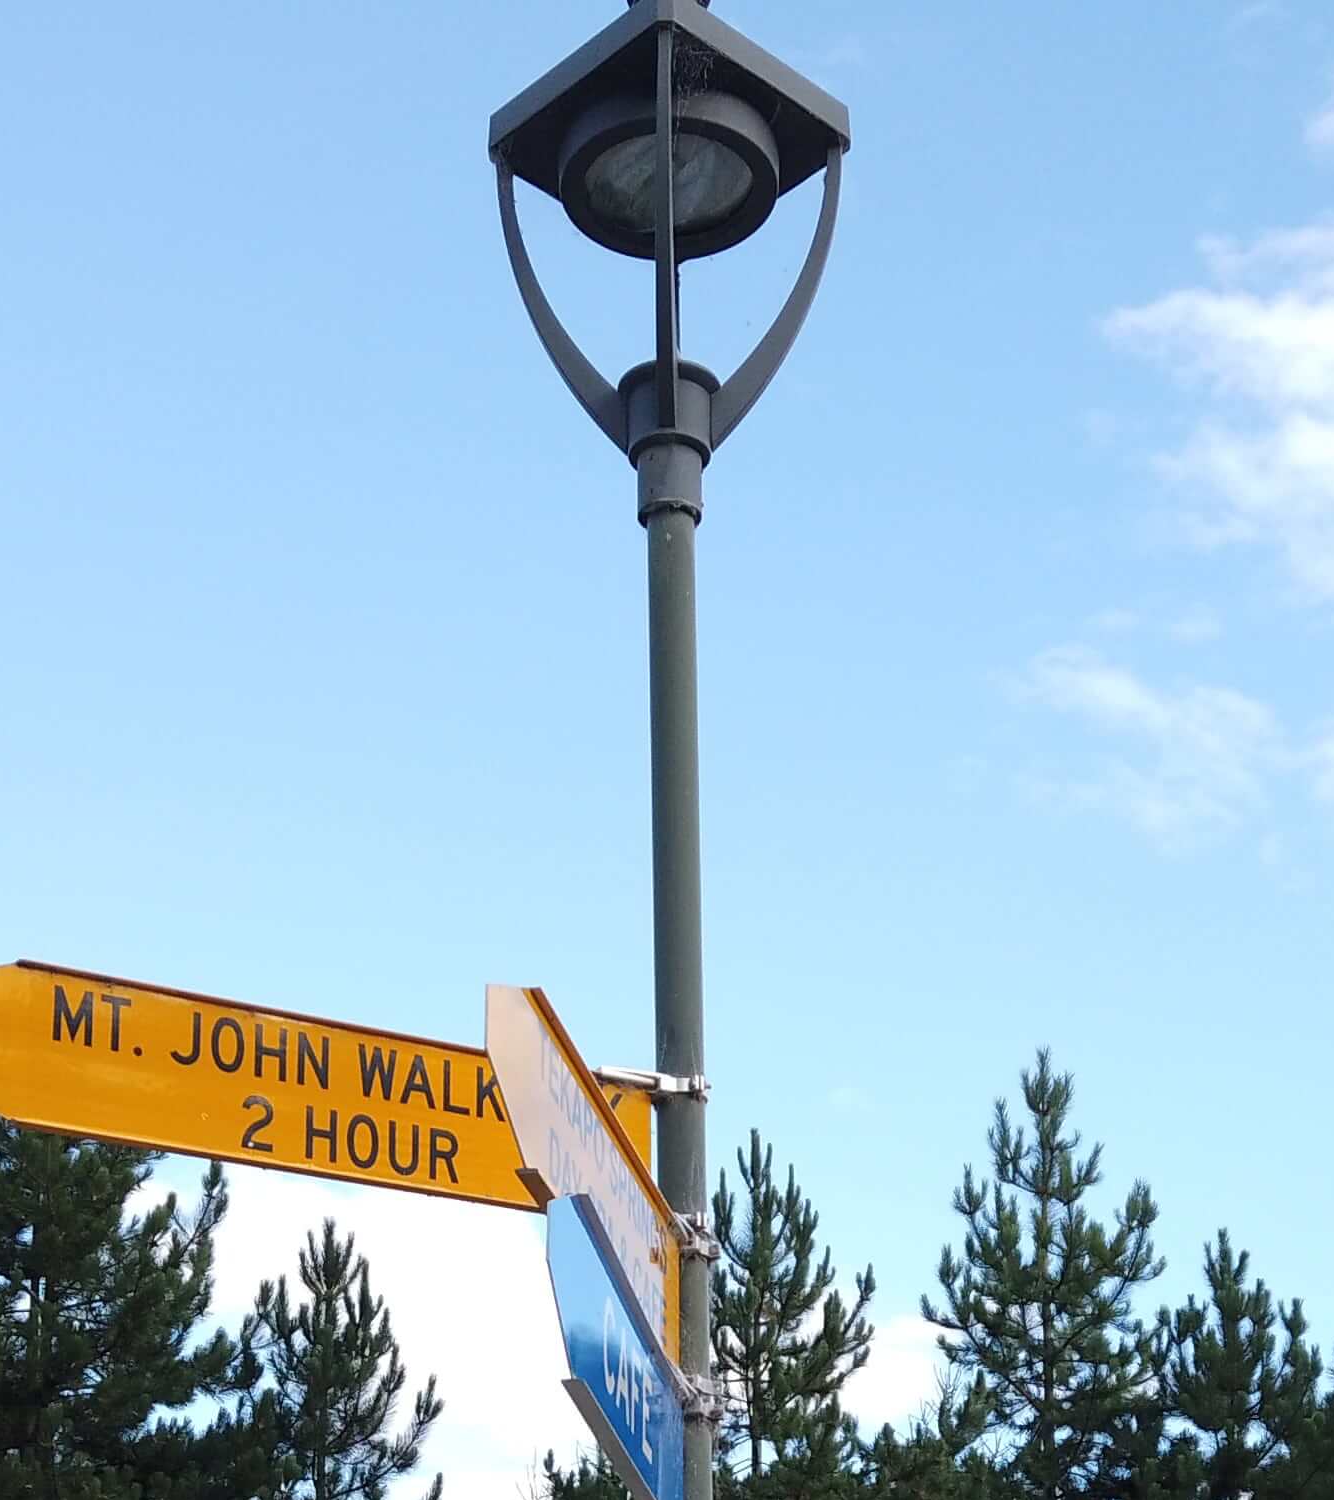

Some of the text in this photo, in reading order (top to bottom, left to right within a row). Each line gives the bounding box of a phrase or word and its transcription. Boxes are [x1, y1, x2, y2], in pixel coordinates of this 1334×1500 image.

[52, 984, 143, 1057] MT.
[170, 1011, 330, 1090] JOHN
[241, 1095, 460, 1185] 2 HOUR
[538, 1017, 605, 1172] TEKAPO
[609, 1139, 667, 1276] SPRINGS
[603, 1296, 654, 1465] CAFE
